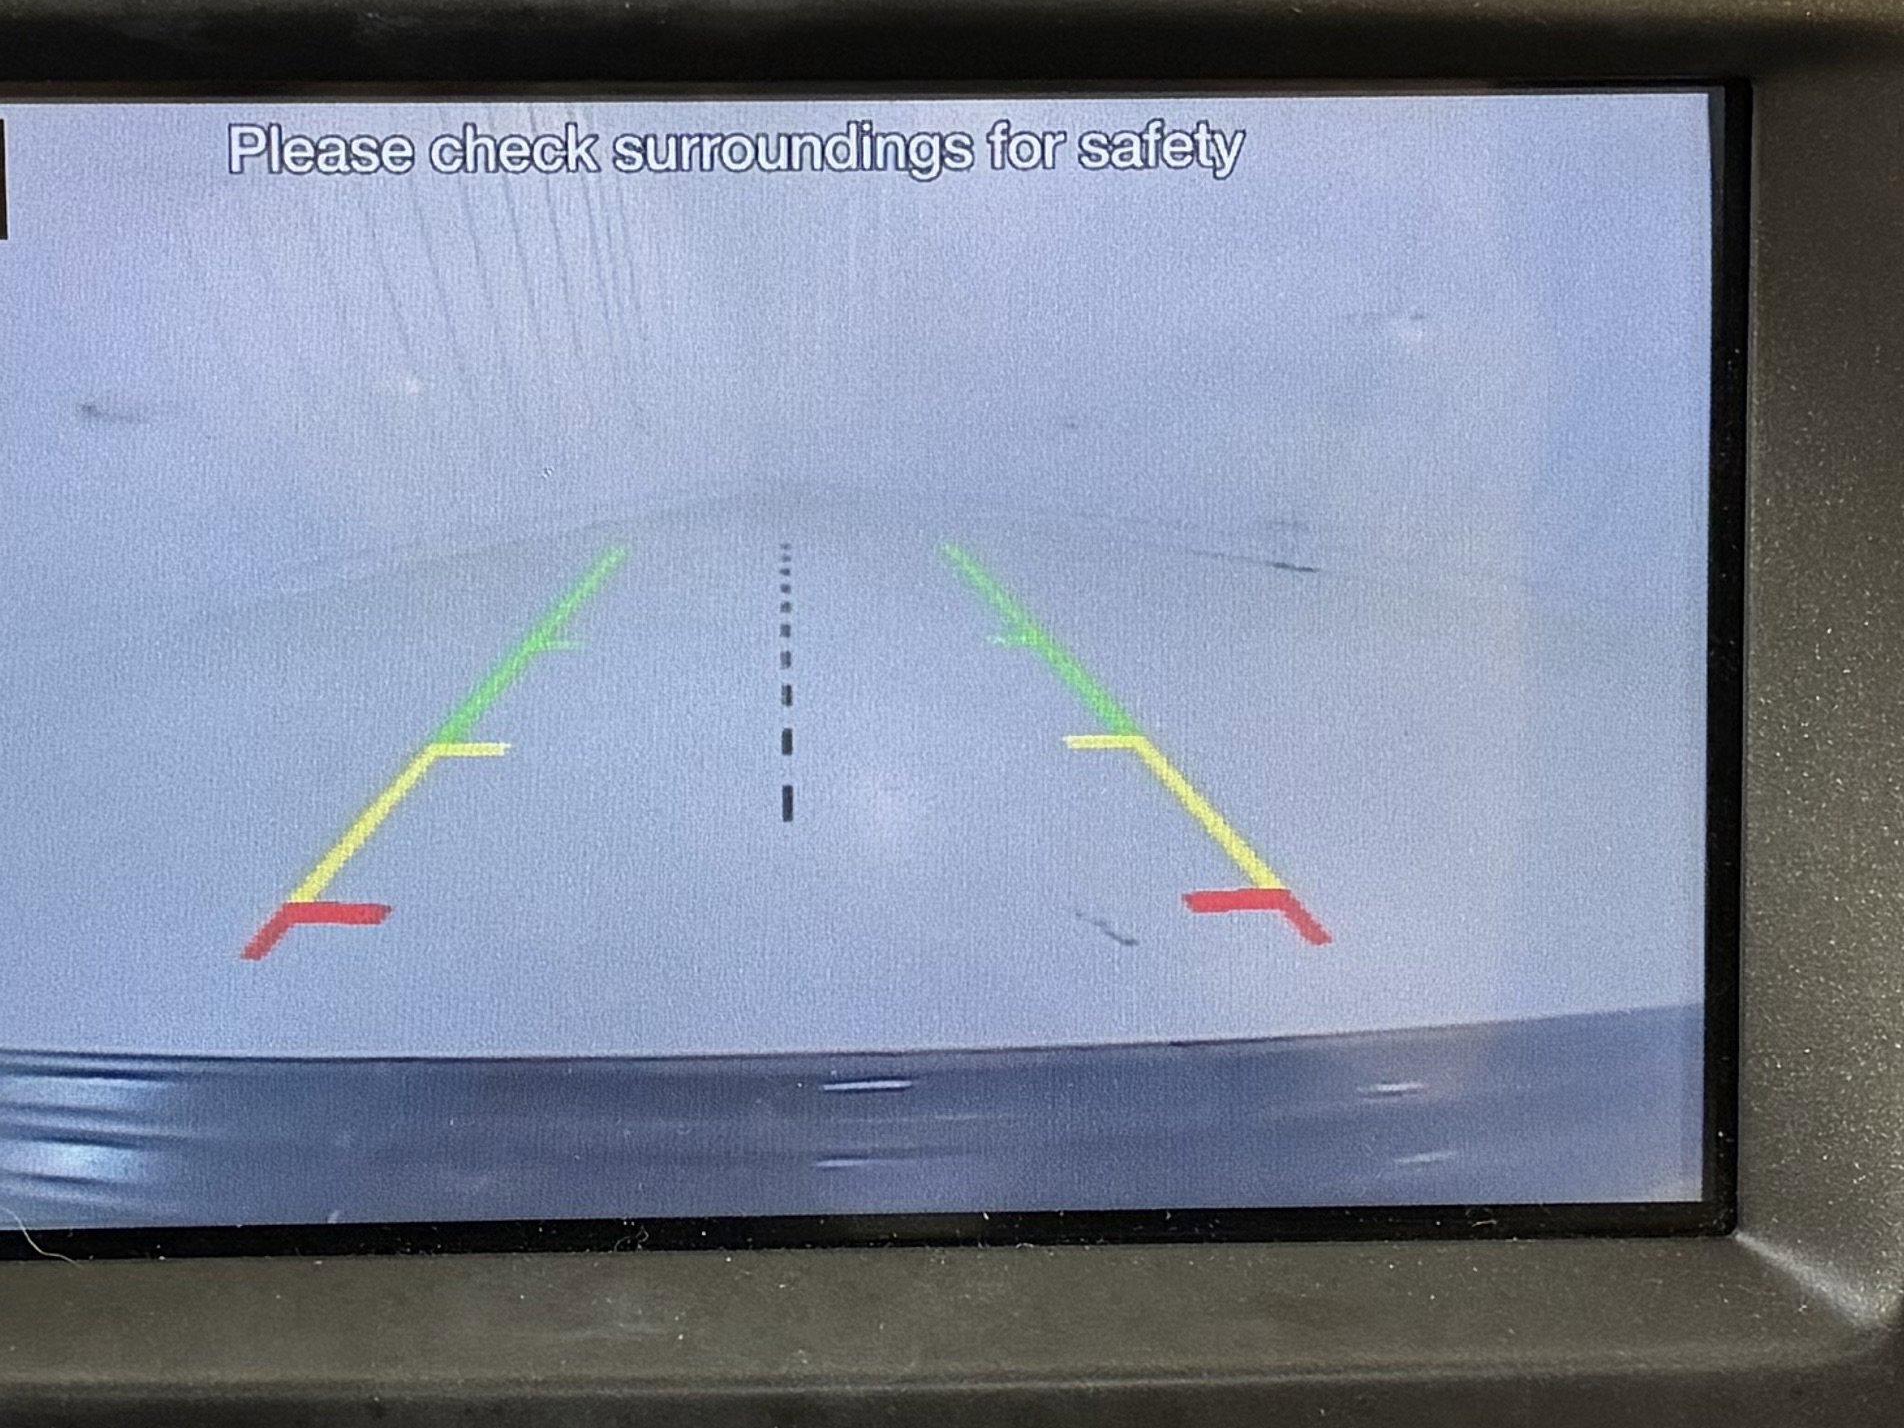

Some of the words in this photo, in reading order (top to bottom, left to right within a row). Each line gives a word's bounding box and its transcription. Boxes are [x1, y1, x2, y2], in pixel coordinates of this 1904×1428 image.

[227, 124, 414, 177] Please
[429, 124, 598, 177] check
[612, 122, 975, 181] surroundings
[986, 121, 1062, 172] for
[1077, 120, 1246, 180] safety
